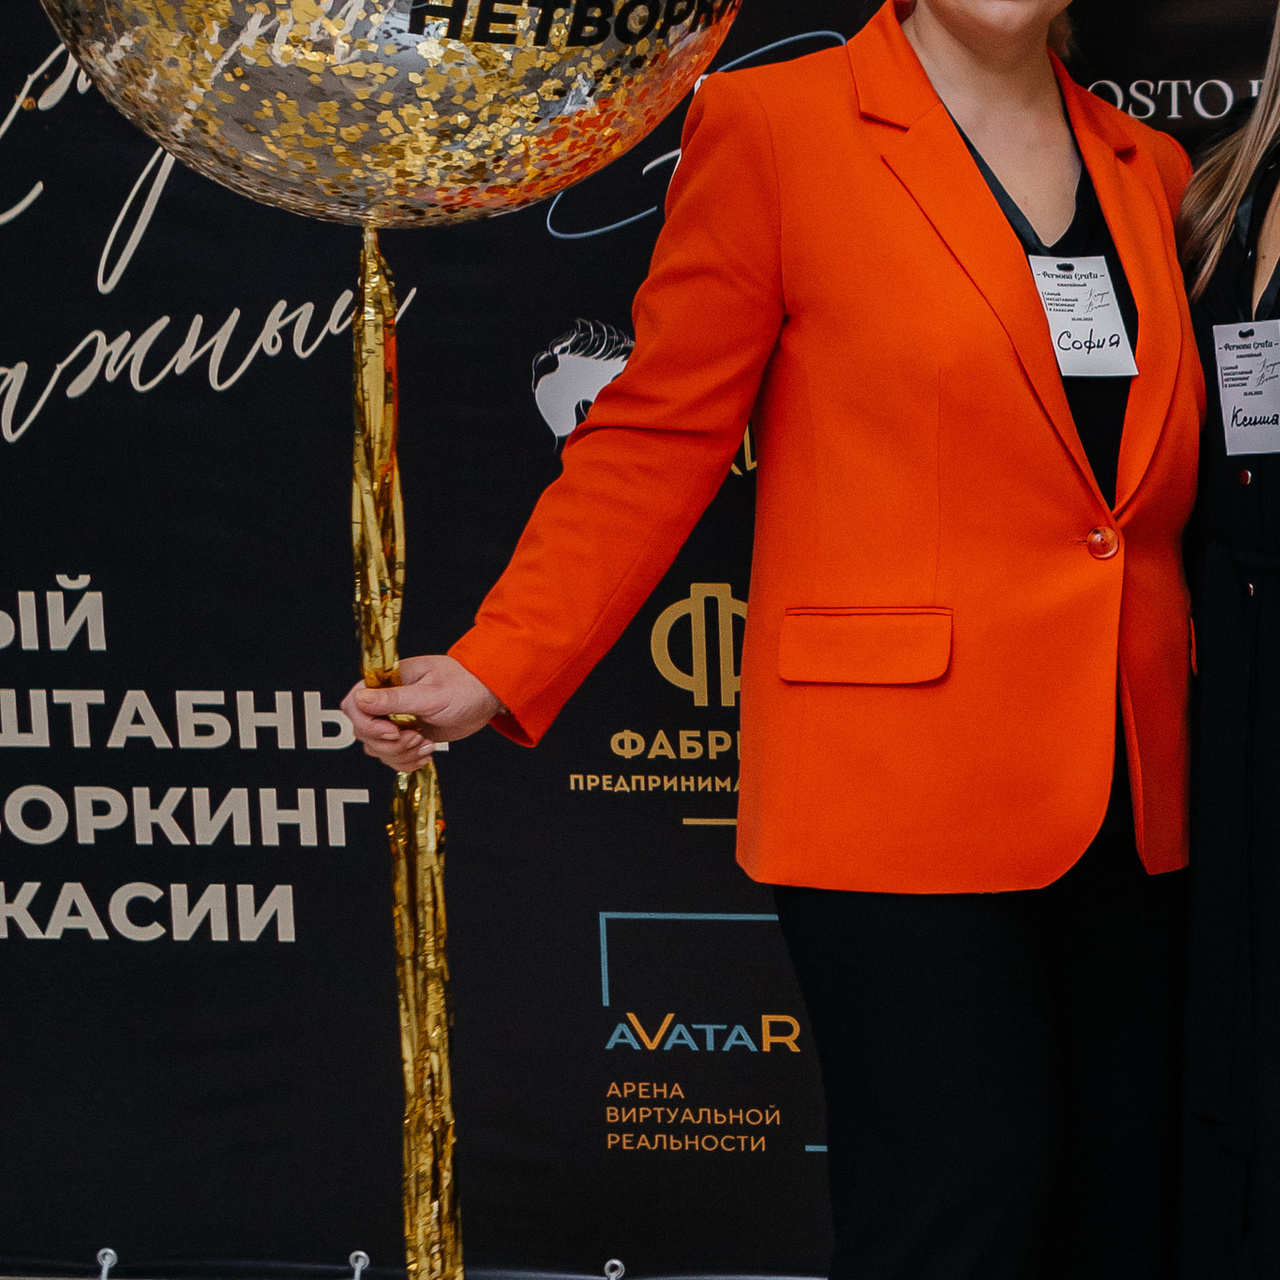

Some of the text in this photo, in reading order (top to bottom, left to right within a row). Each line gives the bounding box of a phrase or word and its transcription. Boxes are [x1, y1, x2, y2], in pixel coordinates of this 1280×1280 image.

[1057, 328, 1121, 355] София
[0, 688, 449, 751] ШТАБНЫ
[610, 729, 740, 760] ФАБР
[0, 785, 369, 847] ОРКИНГ
[606, 1081, 686, 1099] АРЕНА
[605, 1104, 781, 1126] ВИРТУАЛЬНОЙ
[606, 1133, 766, 1152] РЕАЛЬНОСТИ
